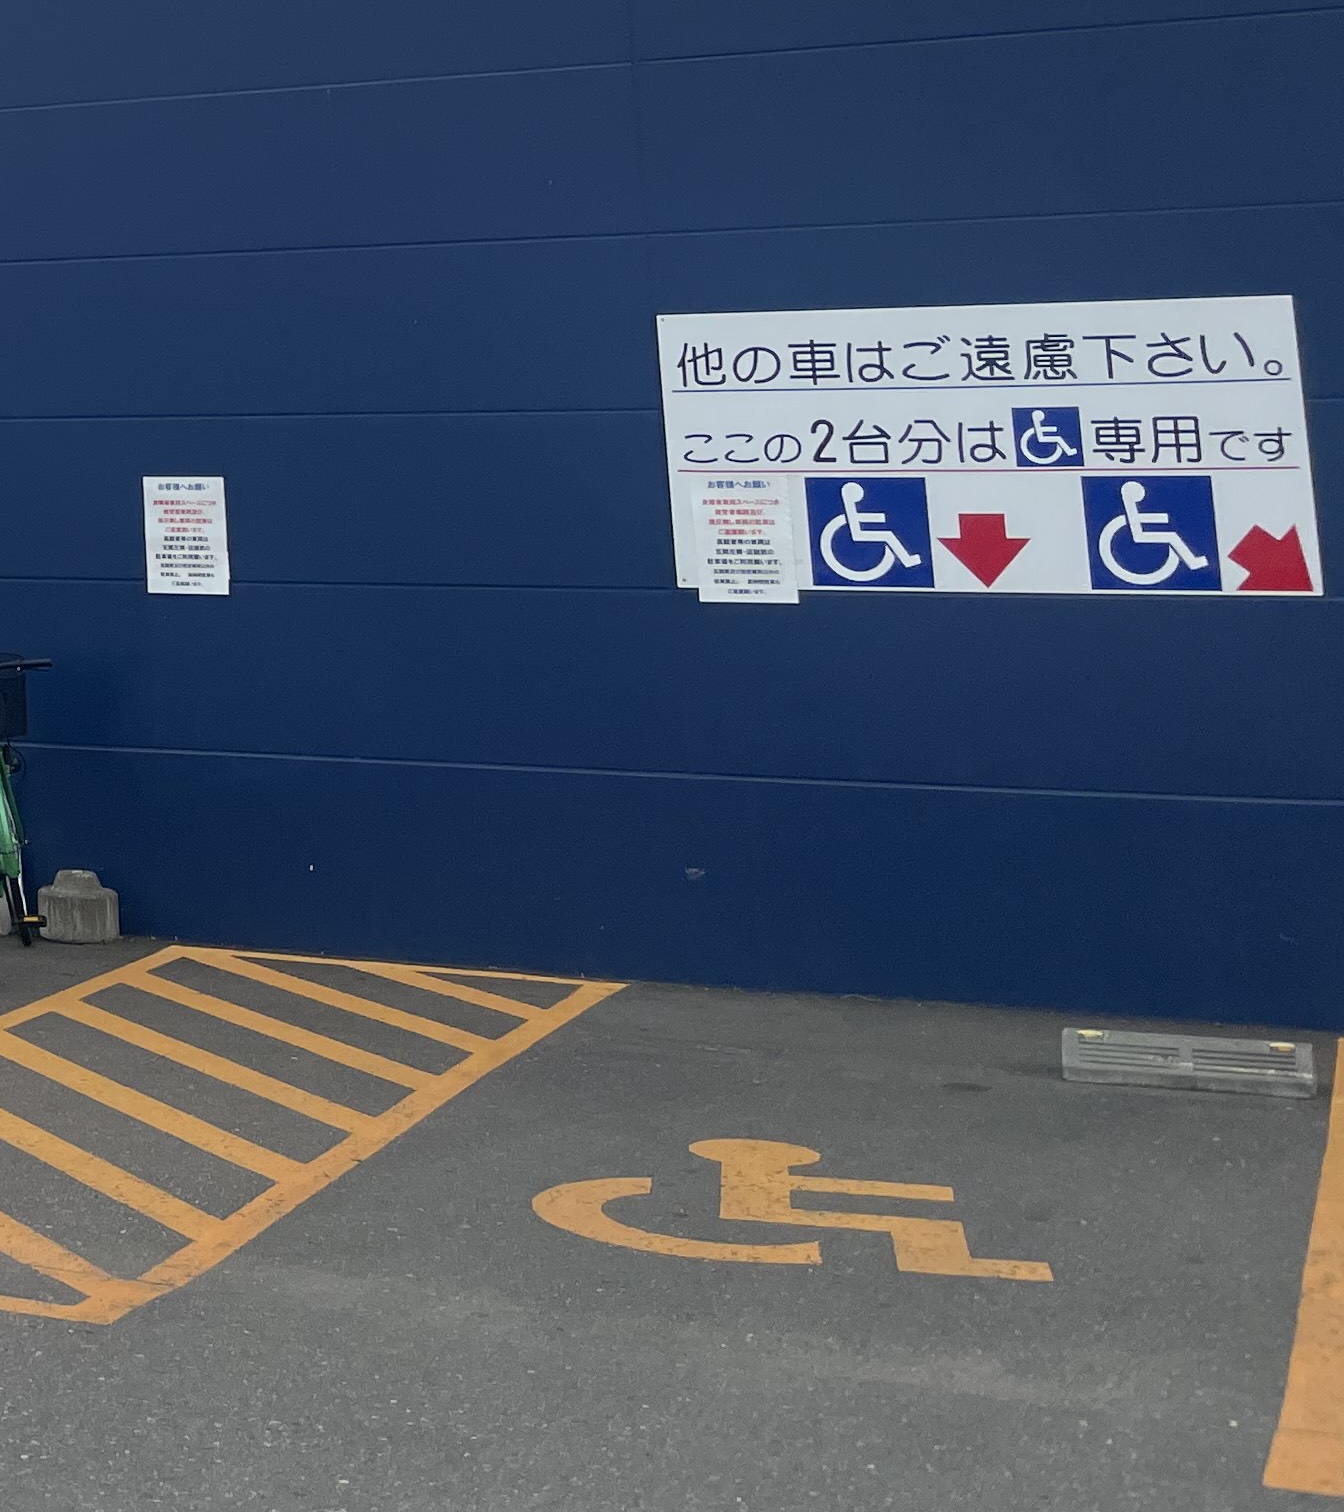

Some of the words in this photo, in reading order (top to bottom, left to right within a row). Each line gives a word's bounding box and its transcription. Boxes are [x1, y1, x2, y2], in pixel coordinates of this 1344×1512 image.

[677, 332, 1284, 388] 他の車はご遠慮下さい。
[1090, 416, 1293, 464] 専用です
